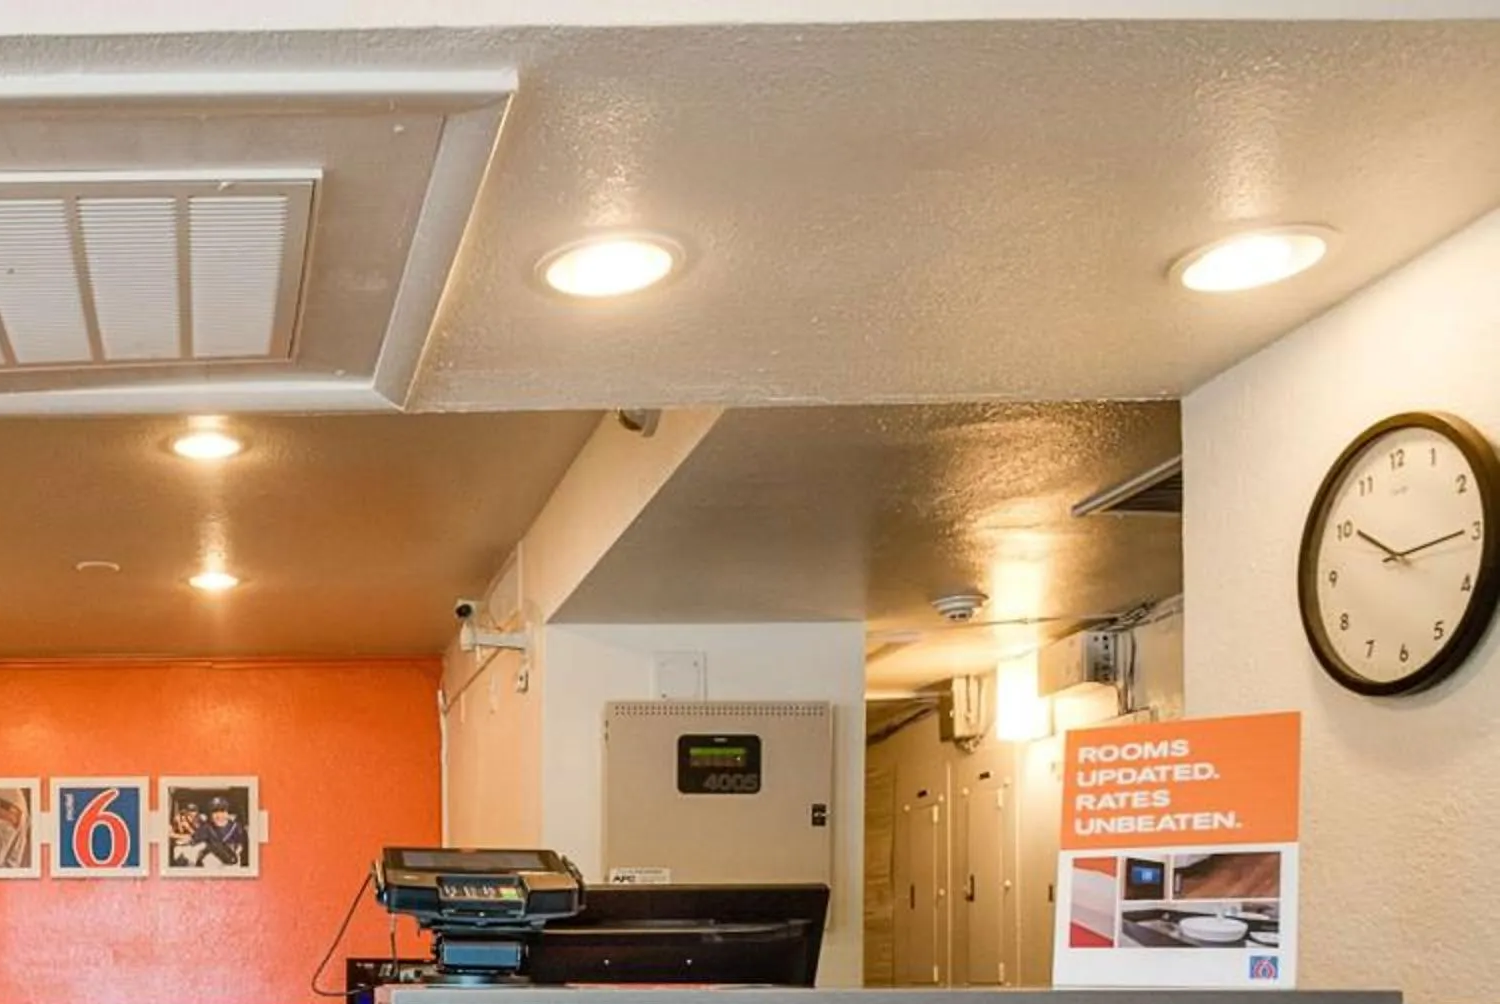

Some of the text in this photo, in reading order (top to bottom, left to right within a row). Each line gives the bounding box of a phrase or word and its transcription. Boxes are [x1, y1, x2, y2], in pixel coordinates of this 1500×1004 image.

[1389, 449, 1406, 470] 12
[1429, 448, 1436, 466] 1
[1359, 476, 1374, 497] 11
[1456, 474, 1467, 493] 2
[1336, 520, 1353, 542] 10
[1471, 521, 1481, 541] 3
[1328, 570, 1338, 588] 9
[1461, 574, 1471, 593] 4
[1339, 613, 1349, 631] 8
[1433, 621, 1445, 641] 5
[1365, 639, 1375, 658] 7
[1399, 643, 1409, 663] 6
[1078, 739, 1190, 764] ROOMS
[1075, 762, 1221, 787] UPDATED.
[1075, 790, 1171, 811] RATES
[72, 787, 131, 868] 6
[1073, 811, 1243, 836] UNBEATEN.
